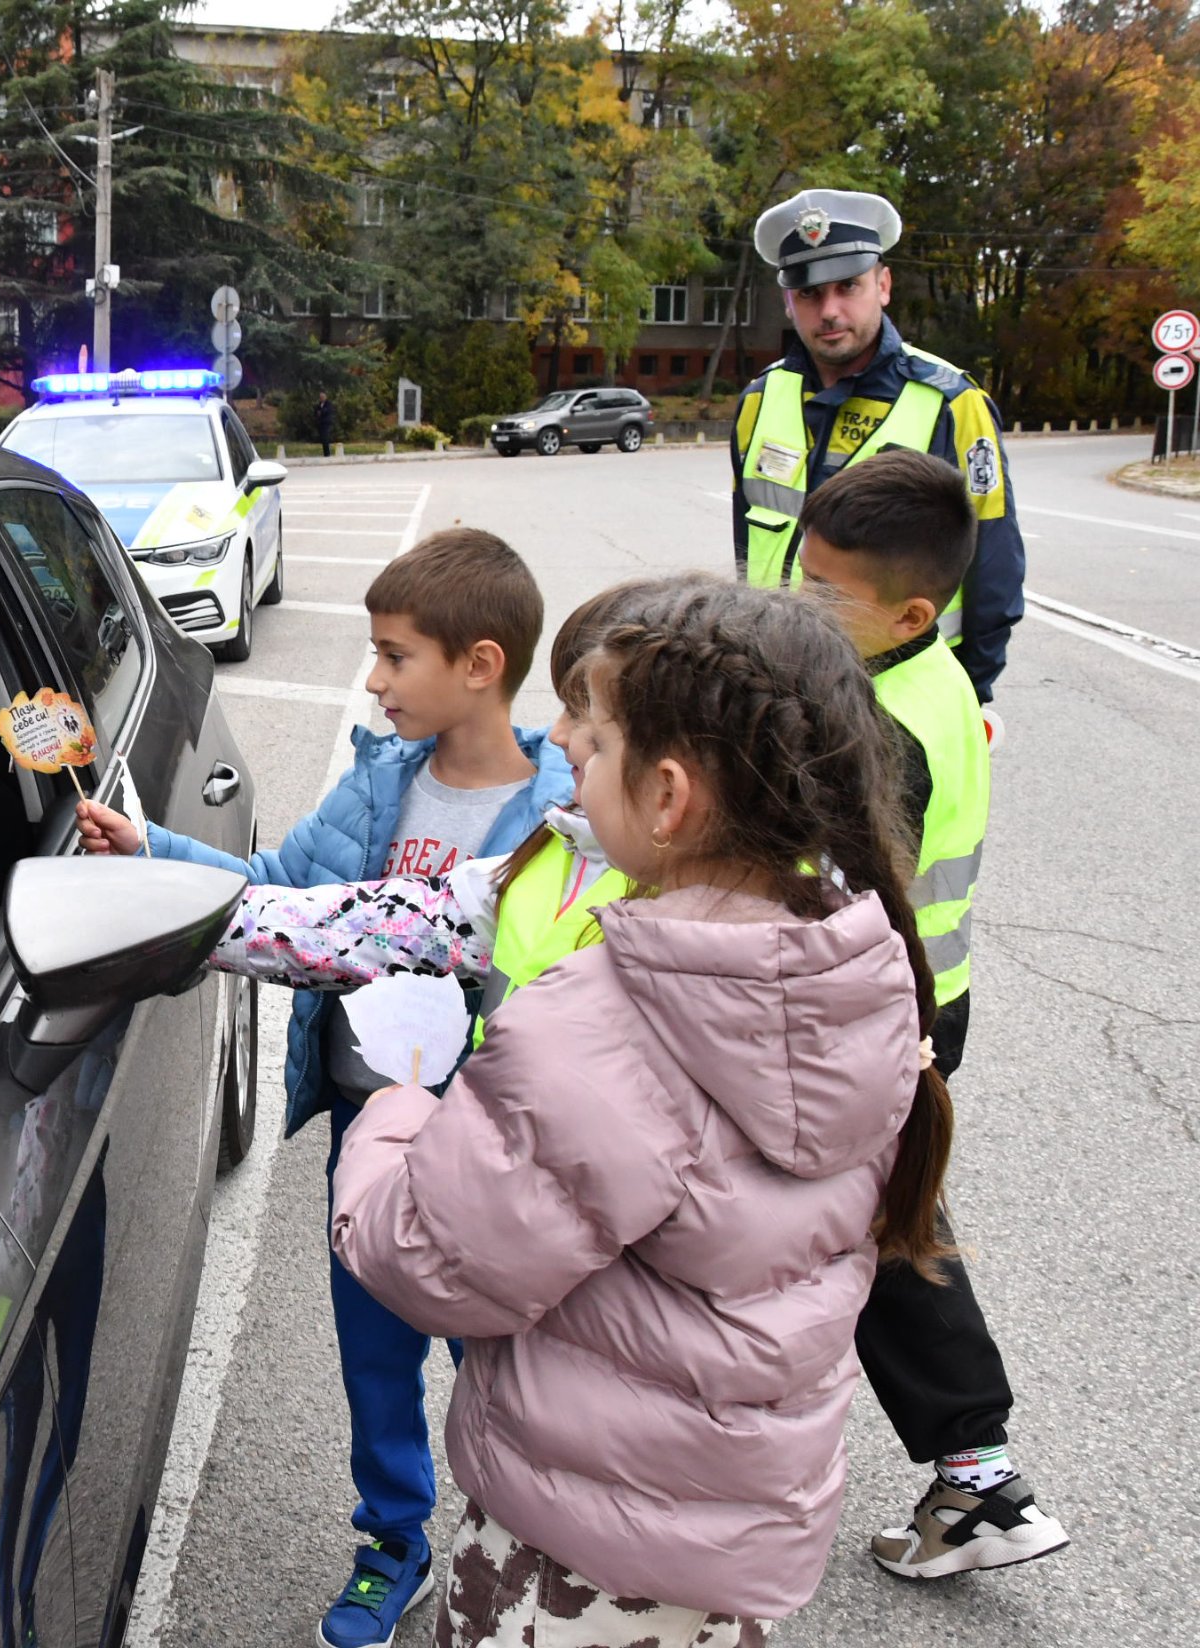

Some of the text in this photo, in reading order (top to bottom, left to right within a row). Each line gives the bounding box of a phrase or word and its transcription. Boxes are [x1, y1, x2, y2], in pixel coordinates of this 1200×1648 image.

[9, 703, 36, 721] Пази
[13, 717, 35, 733] себе
[36, 708, 50, 722] си!
[381, 838, 475, 877] GREA
